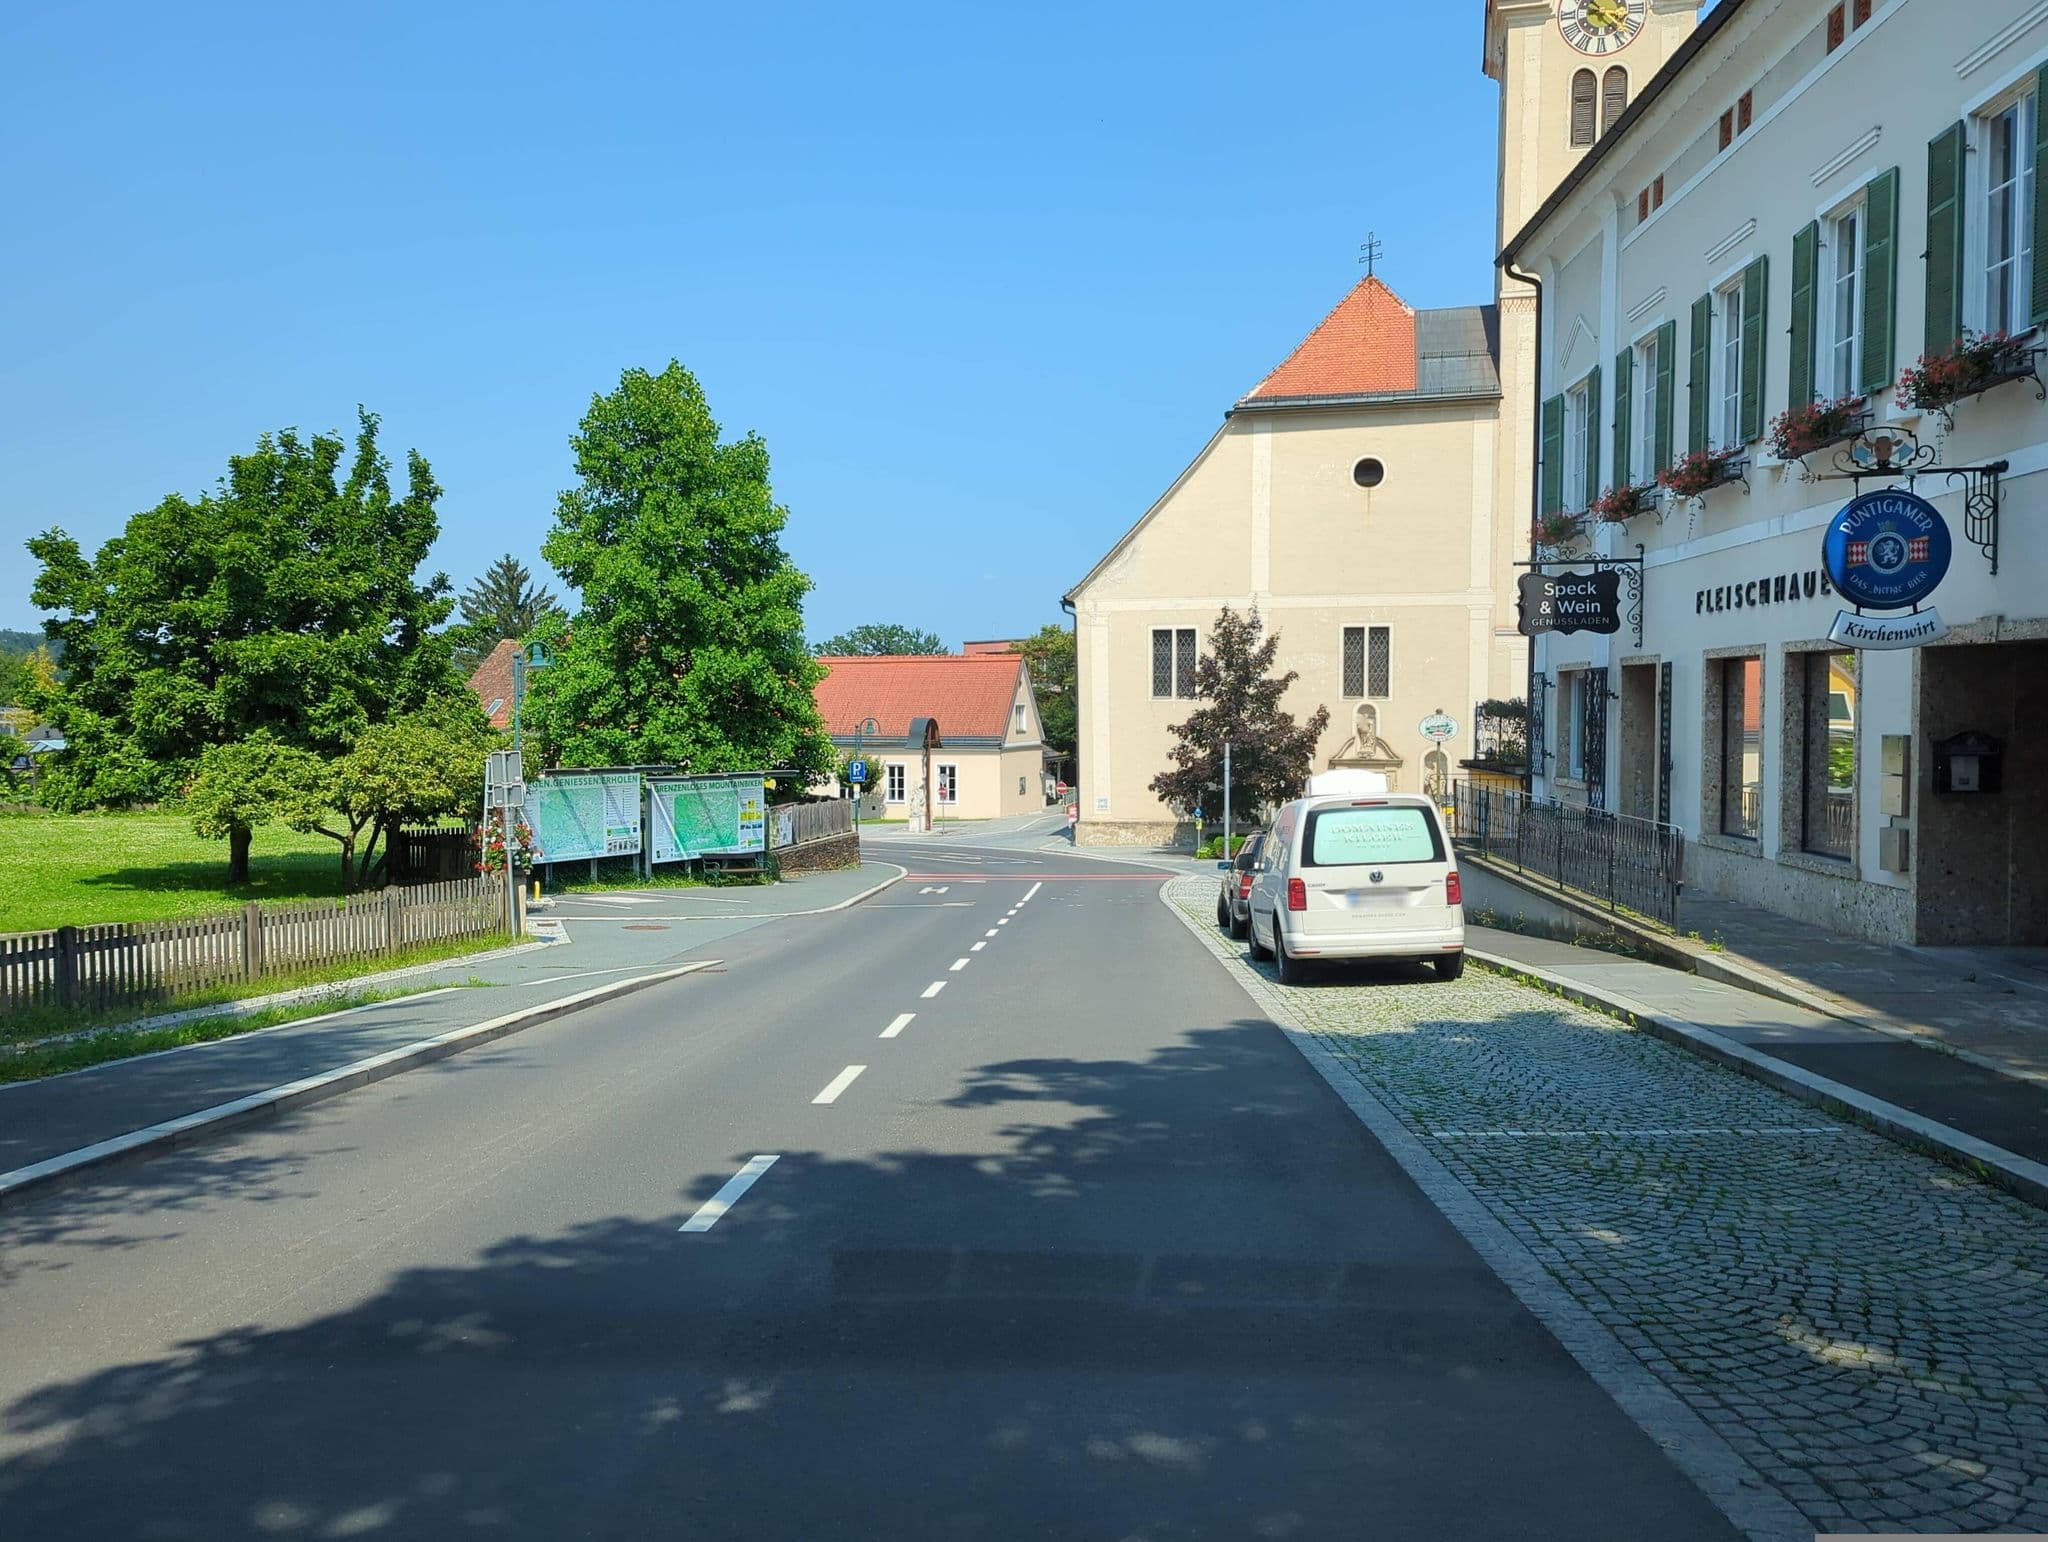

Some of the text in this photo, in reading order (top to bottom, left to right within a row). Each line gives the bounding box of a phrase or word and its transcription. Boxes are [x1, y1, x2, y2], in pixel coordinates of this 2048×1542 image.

[1839, 499, 1933, 535] PUNTIGAMER
[1544, 581, 1597, 598] Speck
[1850, 573, 1869, 590] DAS
[1696, 570, 1831, 615] FLEISCHHAUE
[1540, 599, 1601, 614] & Wein
[1531, 616, 1610, 626] GENUSSLADEN
[1843, 620, 1936, 641] Kirchenwirt
